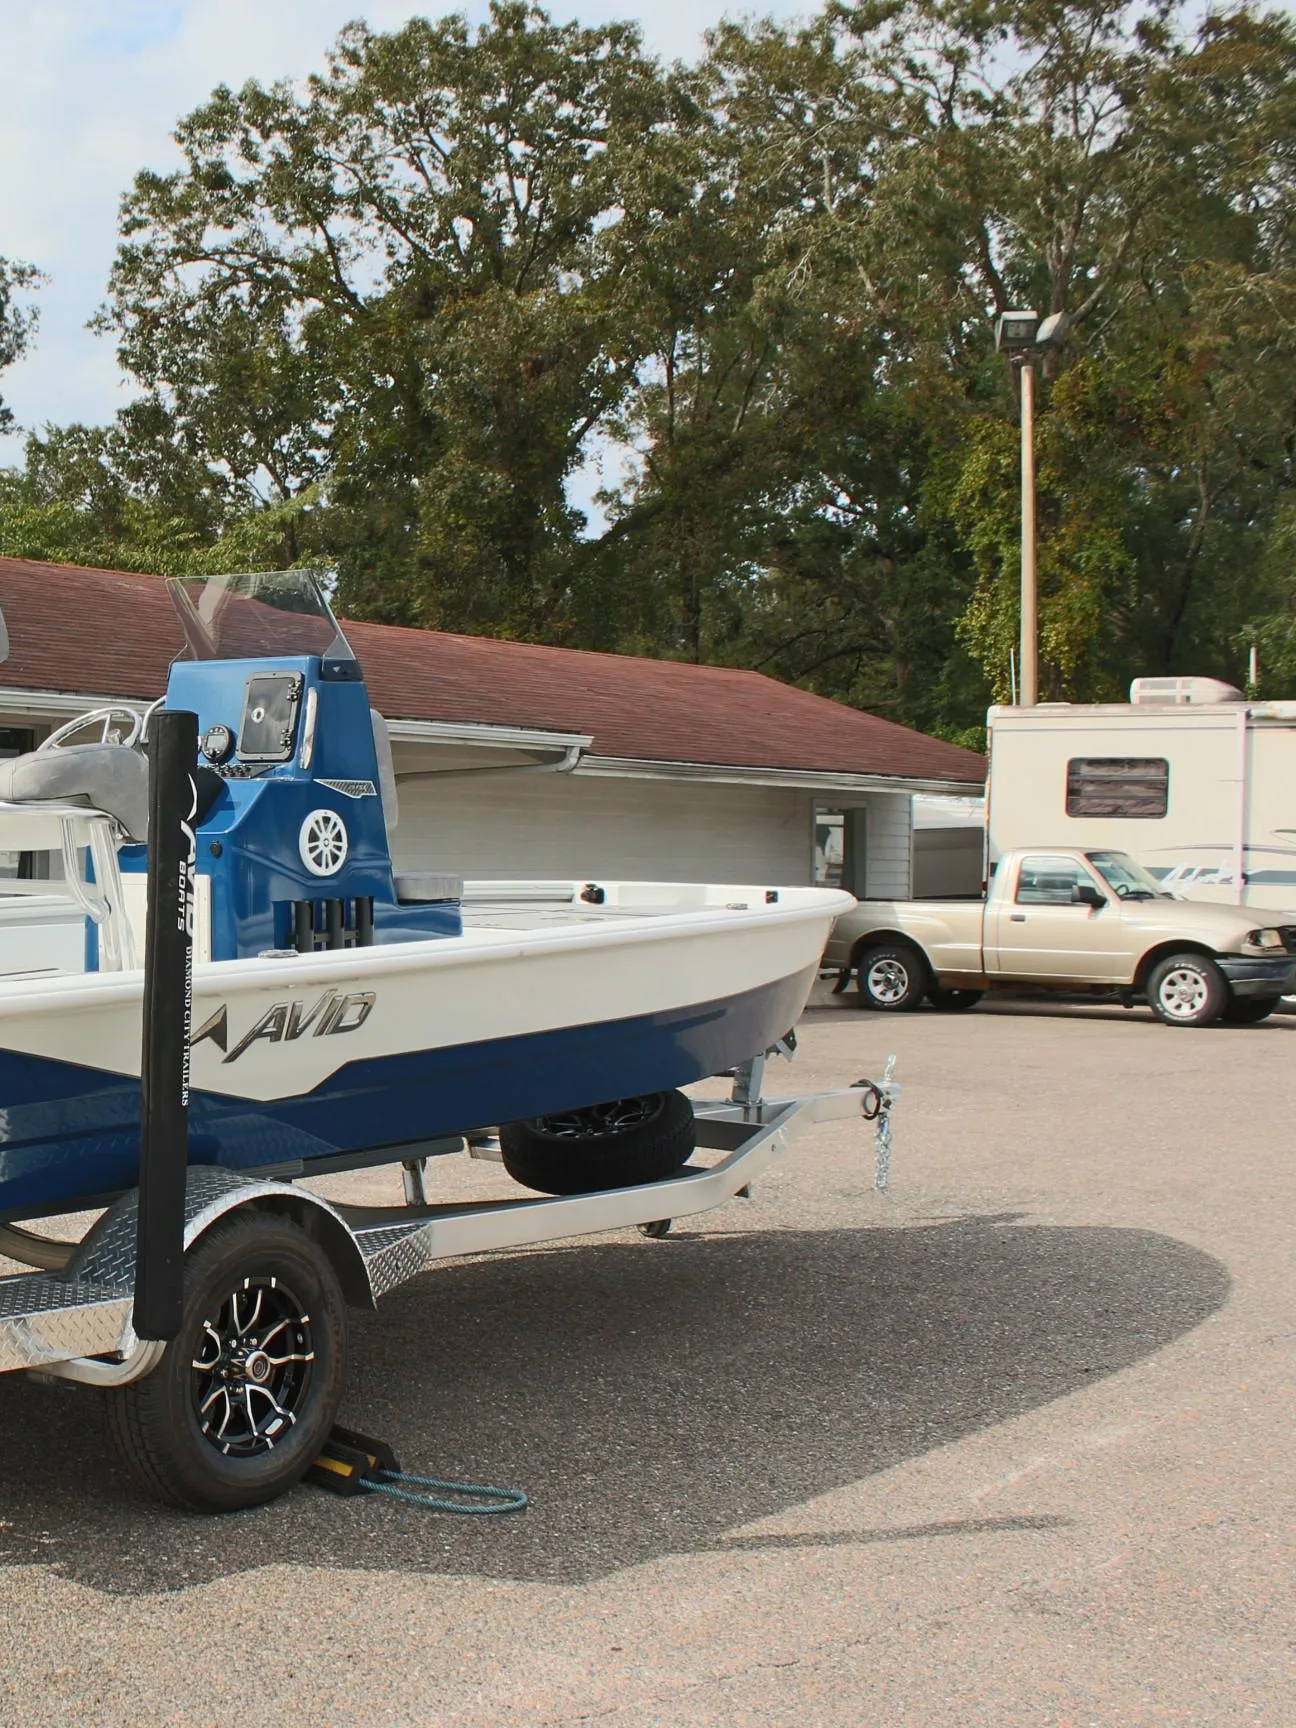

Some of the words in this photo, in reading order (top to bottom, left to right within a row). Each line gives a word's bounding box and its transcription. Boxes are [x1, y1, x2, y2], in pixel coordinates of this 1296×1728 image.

[177, 860, 187, 931] BOATS
[184, 946, 193, 1008] DIAMOND
[183, 1010, 191, 1039] CITY
[221, 988, 376, 1064] AVID
[181, 1042, 191, 1107] TRAILERS
